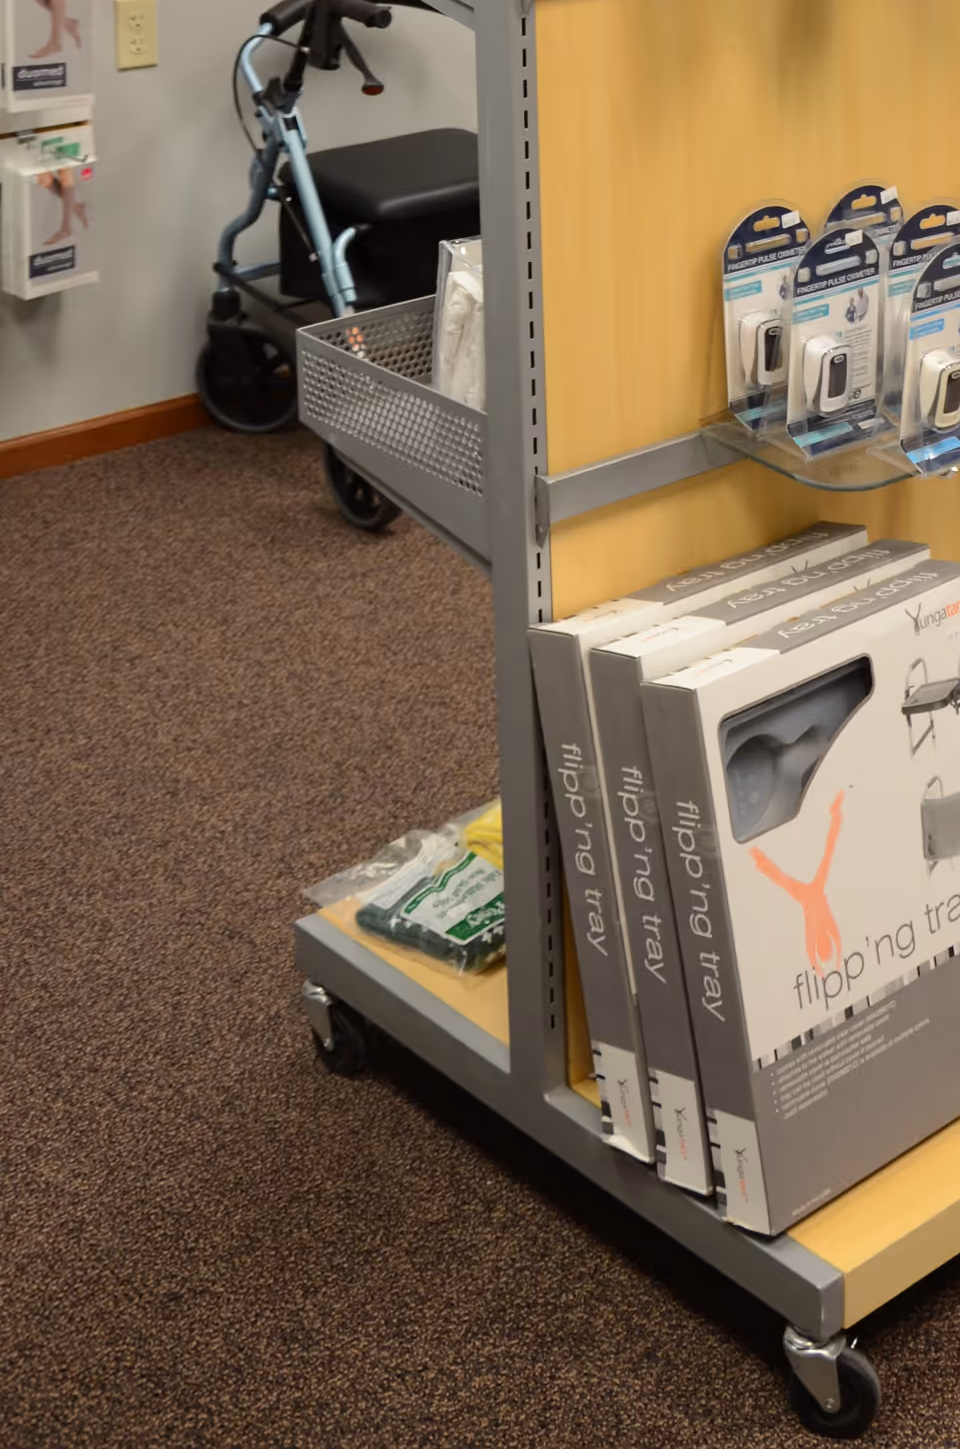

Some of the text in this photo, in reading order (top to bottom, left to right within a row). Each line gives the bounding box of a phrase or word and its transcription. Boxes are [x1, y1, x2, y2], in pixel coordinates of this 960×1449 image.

[17, 65, 64, 79] duomed
[33, 249, 73, 266] duomed
[728, 245, 808, 271] FINGERTIP PULSE OXIMETER
[892, 255, 922, 267] FINGERTIP
[796, 267, 876, 295] FINGERTIP PULSE OXIMETER
[915, 295, 944, 310] FINGERTIP
[664, 569, 725, 592] tray
[727, 548, 890, 609] flipp'ng tray
[777, 571, 939, 639] flipp'ng tray
[557, 741, 608, 957] flipp'ng tray
[617, 765, 667, 985] flipp'ng tray
[672, 799, 726, 1023] flipp'ng tray
[793, 919, 916, 1011] flipp'ng
